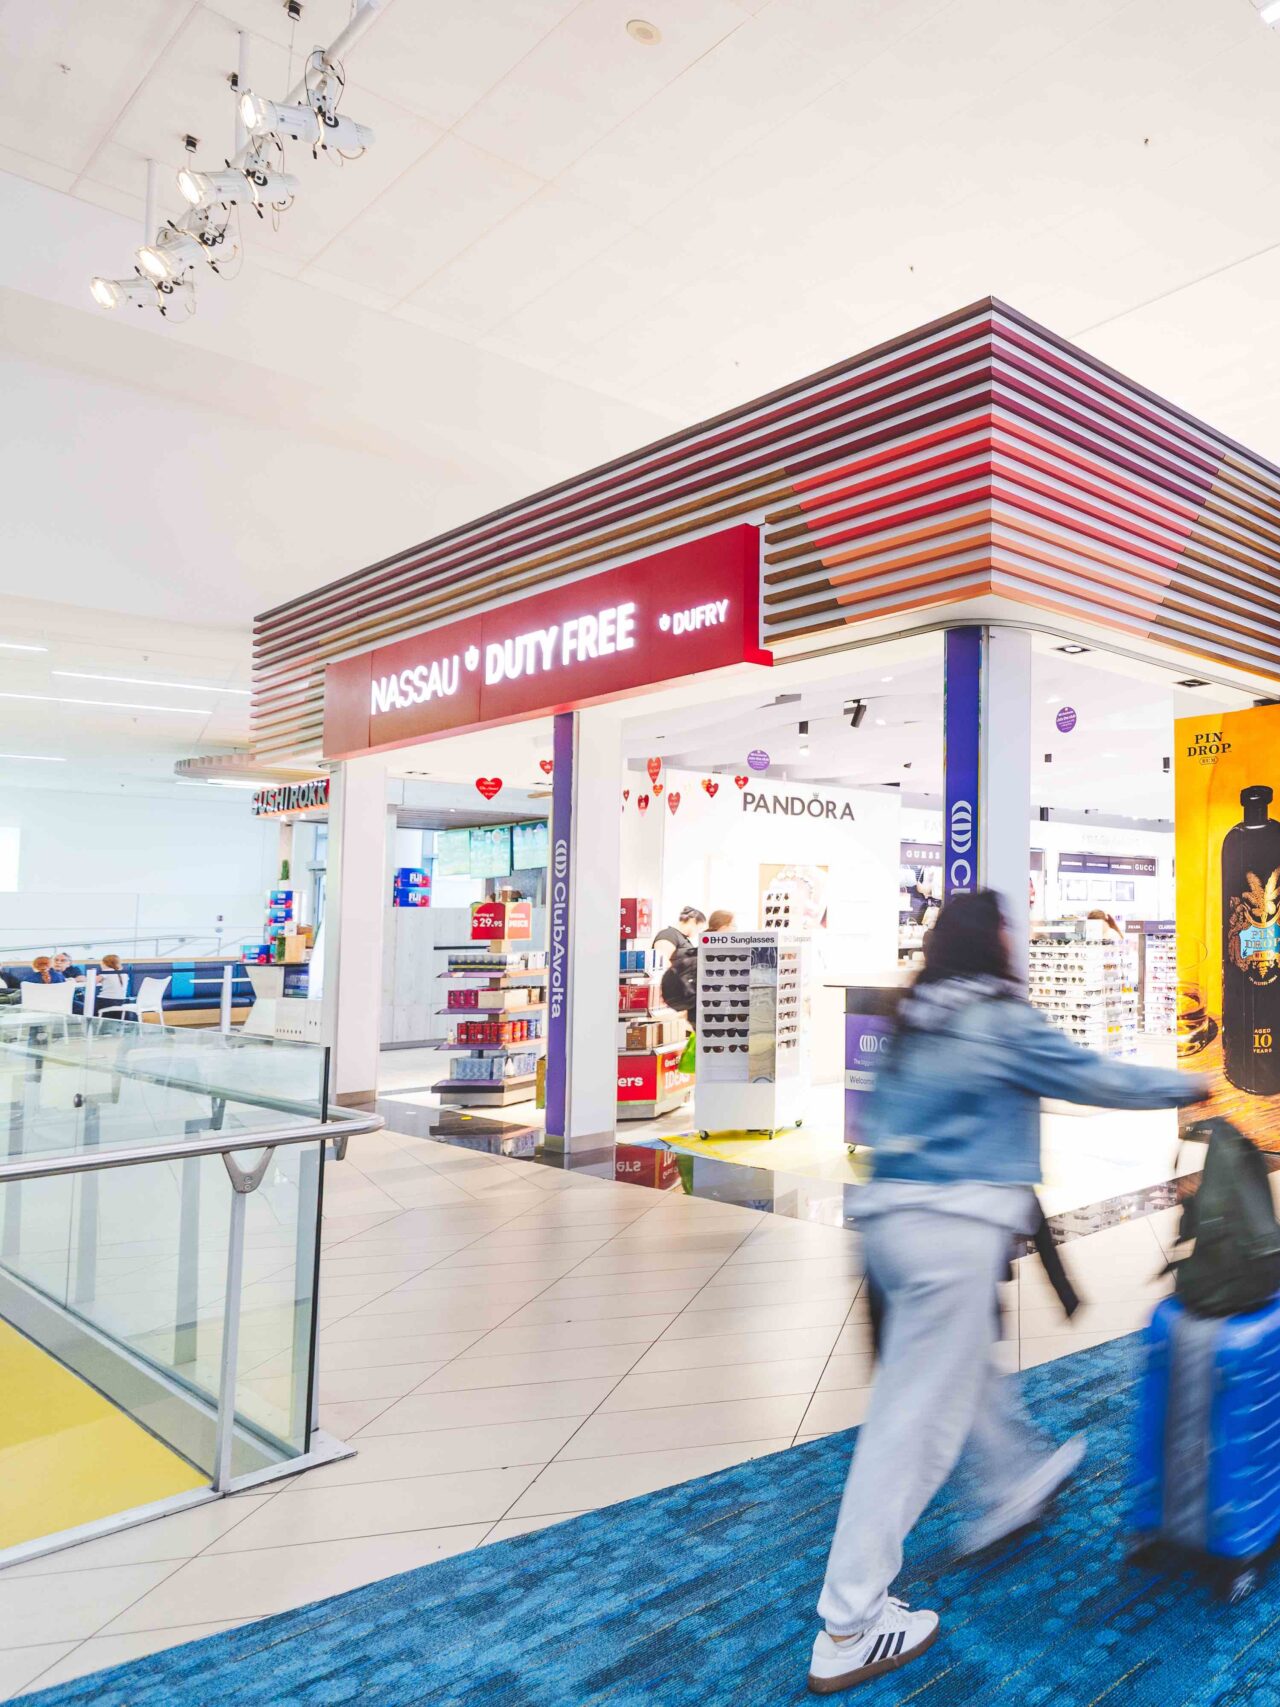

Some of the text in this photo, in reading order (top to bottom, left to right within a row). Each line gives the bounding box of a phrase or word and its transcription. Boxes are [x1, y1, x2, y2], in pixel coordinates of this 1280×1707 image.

[673, 598, 729, 635] DUFRY
[371, 602, 635, 715] NASSAU DUTY FREE
[1195, 731, 1224, 744] PIN
[1187, 743, 1232, 757] DROP
[905, 849, 941, 860] GUESS
[1134, 863, 1155, 872] GUCCI
[730, 936, 775, 945] Sunglasses
[552, 881, 567, 1019] ClubAvolta
[1253, 1034, 1273, 1048] 10
